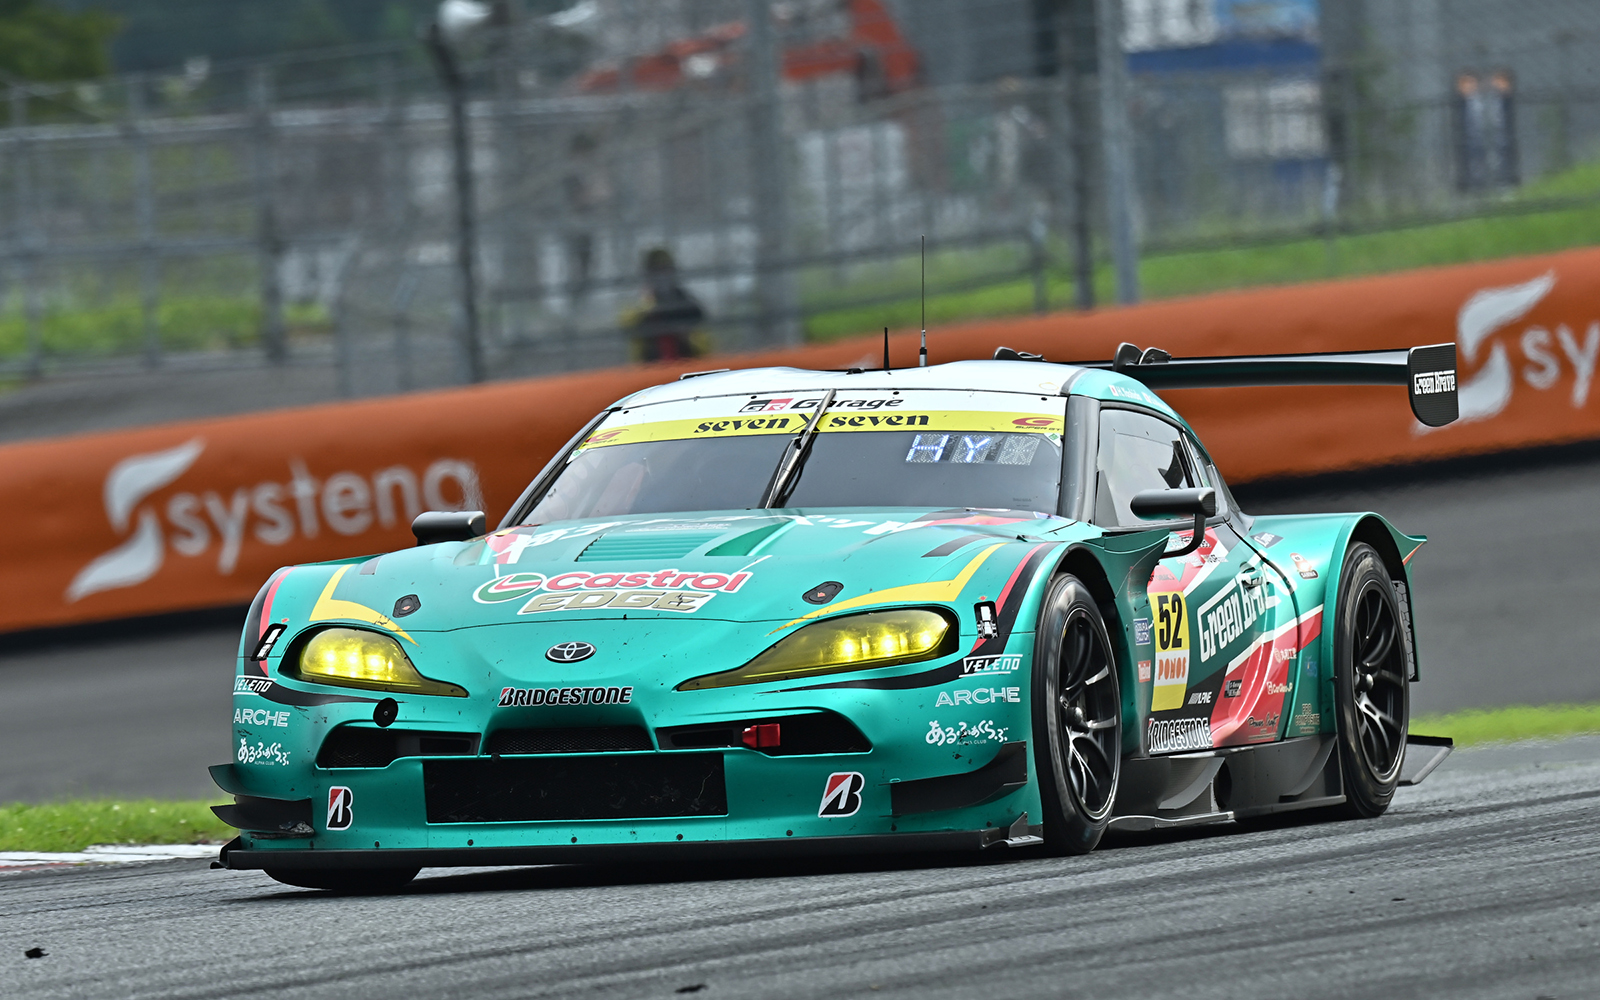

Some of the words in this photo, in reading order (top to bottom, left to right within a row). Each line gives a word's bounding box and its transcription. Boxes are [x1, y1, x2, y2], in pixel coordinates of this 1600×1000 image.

[1414, 372, 1434, 395] Green
[1434, 370, 1456, 393] Brave
[693, 417, 790, 434] seven
[828, 412, 930, 428] seven
[544, 570, 752, 593] Castrol
[522, 591, 711, 613] EDGE
[1157, 593, 1183, 650] 52
[1197, 577, 1244, 663] Green
[959, 654, 1023, 677] VELENO
[1157, 656, 1187, 680] PONOS
[233, 676, 277, 695] VELENO
[498, 686, 633, 707] BRIDGESTONE
[935, 687, 1021, 707] ARCHE
[233, 708, 290, 727] ARCHE
